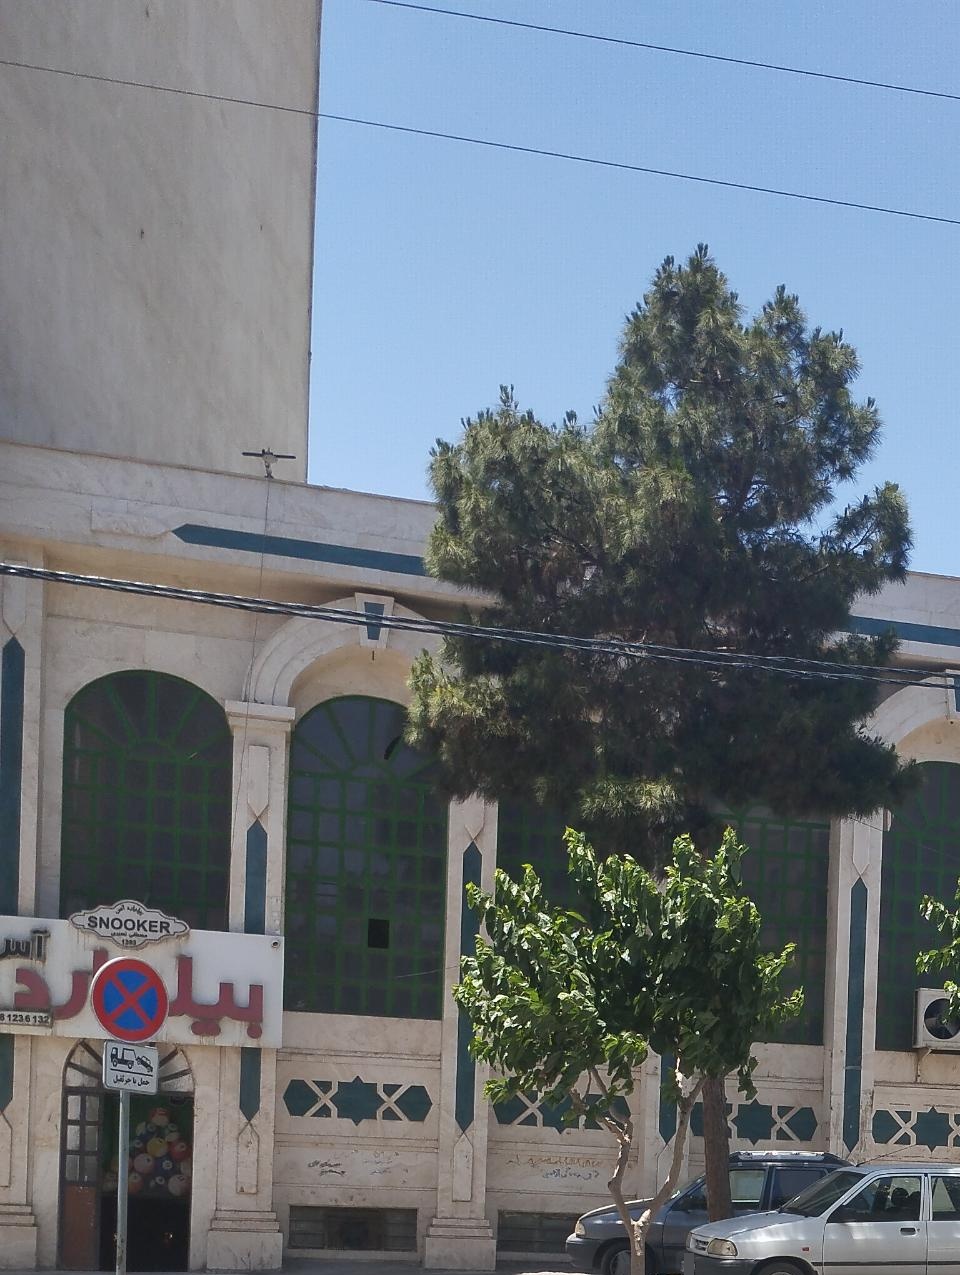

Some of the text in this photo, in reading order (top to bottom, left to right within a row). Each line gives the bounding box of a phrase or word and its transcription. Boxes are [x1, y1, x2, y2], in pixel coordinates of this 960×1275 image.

[87, 915, 171, 934] SNOOKER
[132, 1076, 137, 1085] با
[137, 1077, 150, 1087] حمل
